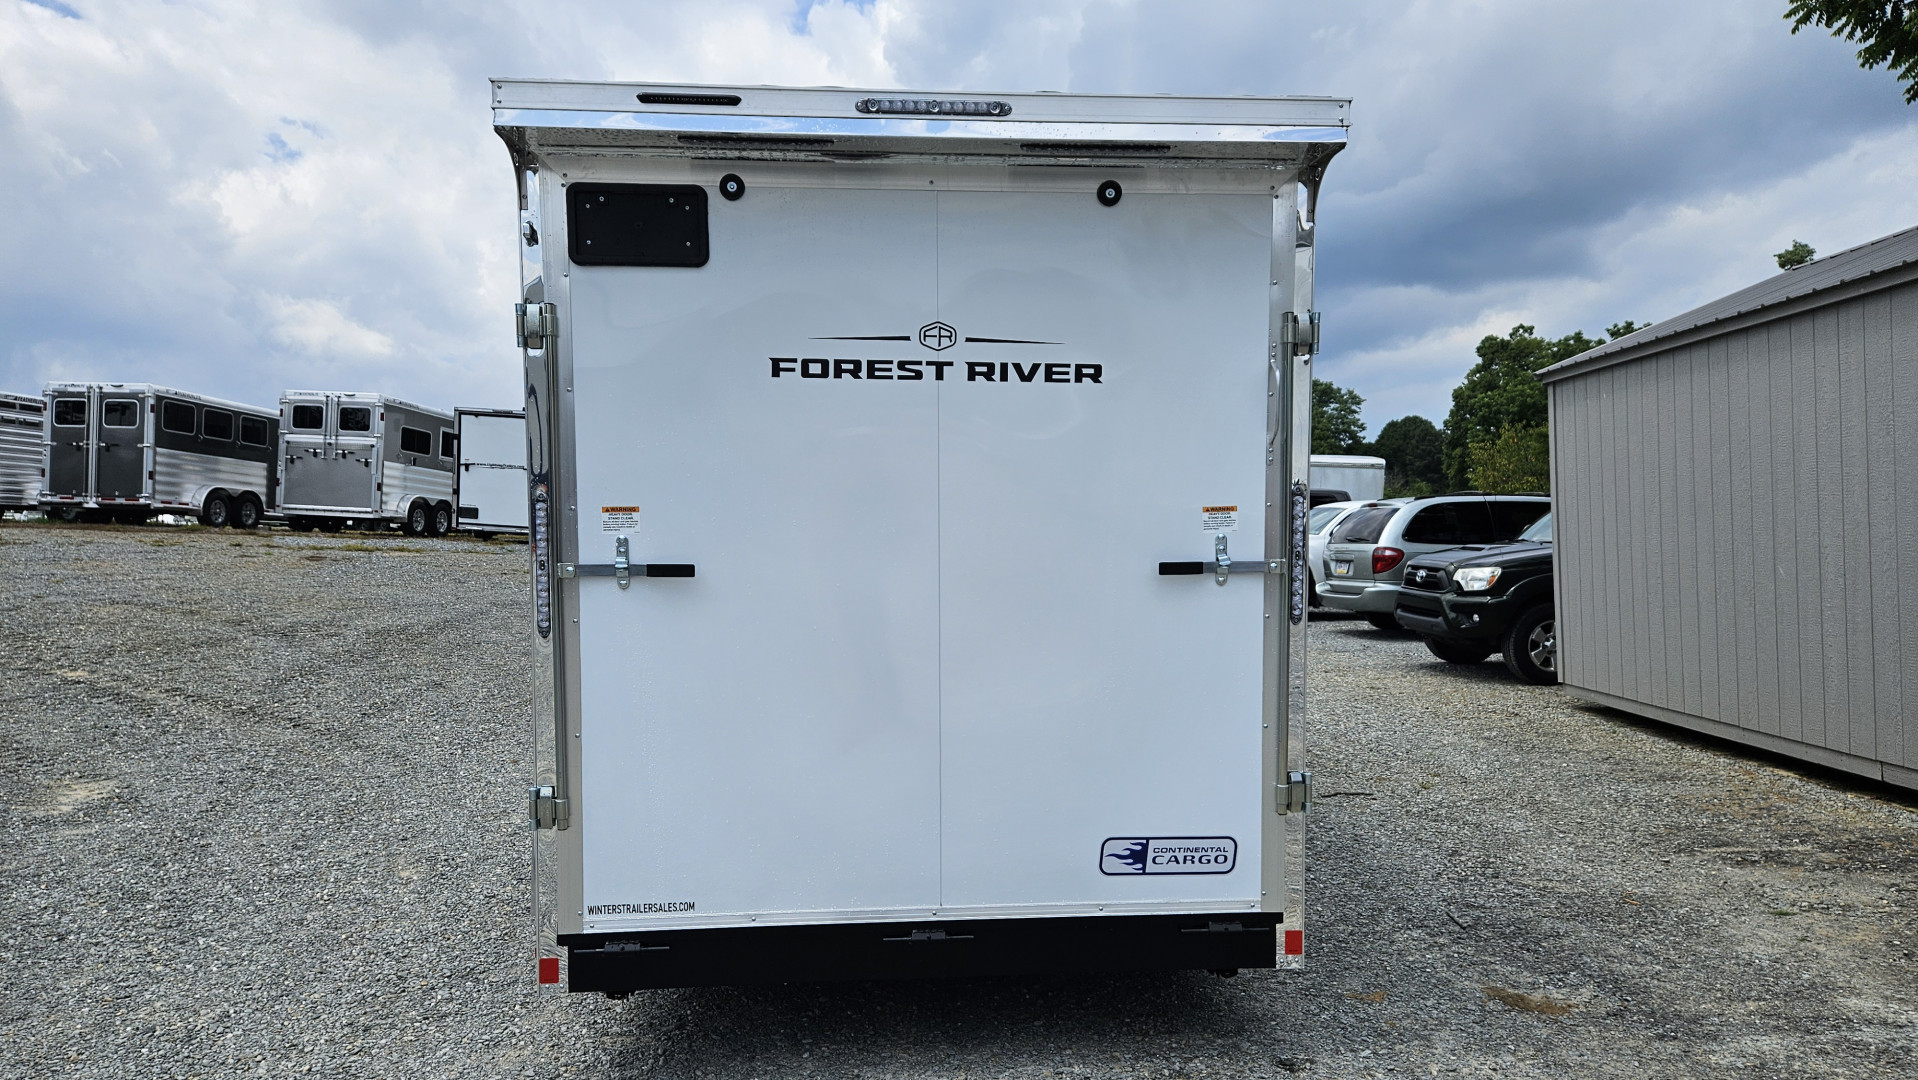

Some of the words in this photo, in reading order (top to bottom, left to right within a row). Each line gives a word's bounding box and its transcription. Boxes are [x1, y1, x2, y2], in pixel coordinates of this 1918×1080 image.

[768, 357, 954, 381] FOREST
[964, 361, 1104, 384] RIVER
[1152, 846, 1229, 854] CONTINENTAL
[1151, 854, 1229, 865] CARGO
[587, 901, 695, 916] WINTERSTRAILERSALES.COM
